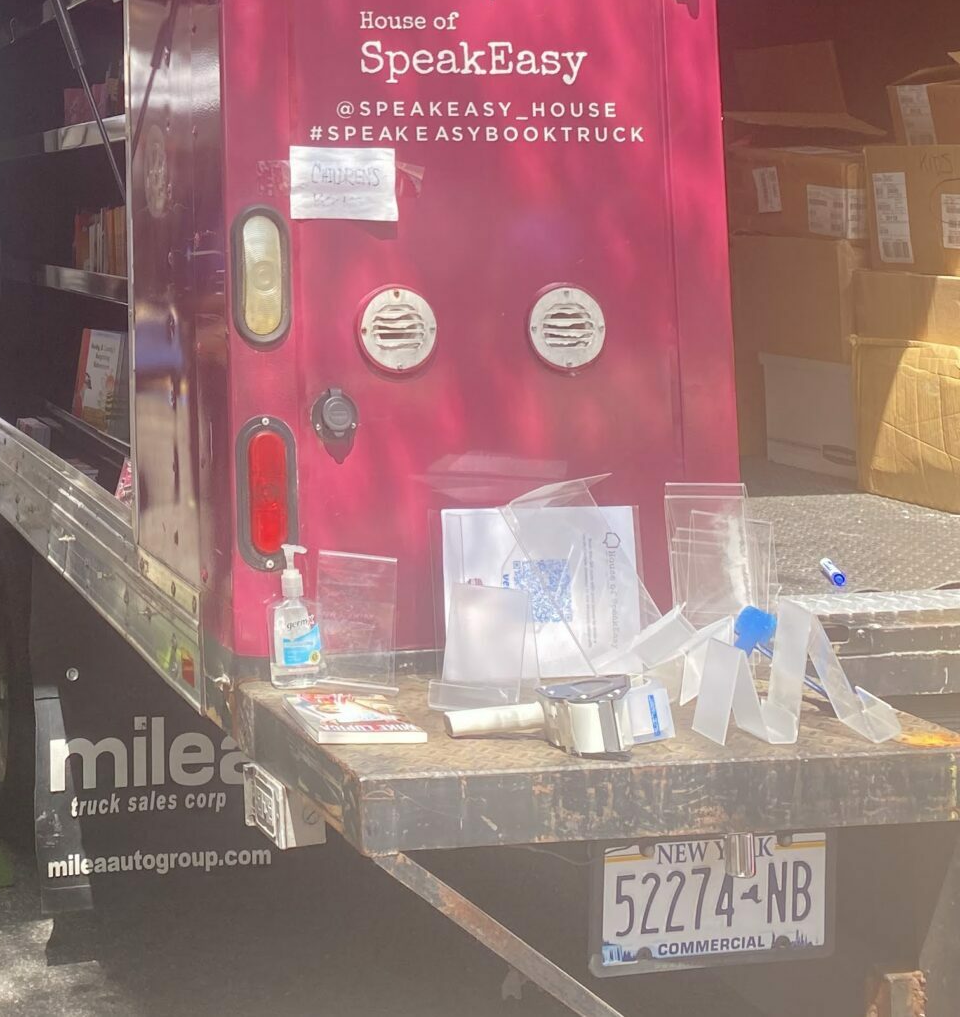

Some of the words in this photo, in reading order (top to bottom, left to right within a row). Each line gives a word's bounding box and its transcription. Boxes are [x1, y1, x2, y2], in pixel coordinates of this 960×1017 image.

[360, 11, 426, 30] House
[433, 11, 460, 30] of
[360, 40, 588, 85] SpeakEasy
[336, 100, 617, 120] @SPEAKEASY_HOUSE
[310, 125, 645, 143] #SPEAKEASYBOOKTRUCK
[50, 716, 246, 792] milea
[71, 793, 121, 818] truck
[128, 790, 177, 812] sales
[185, 791, 227, 812] corp
[48, 848, 272, 878] mileaautogroup.com
[656, 843, 708, 865] NEW
[715, 836, 774, 861] YK
[615, 866, 736, 937] 52274
[767, 860, 813, 924] NB
[658, 935, 766, 957] COMMERCIAL
